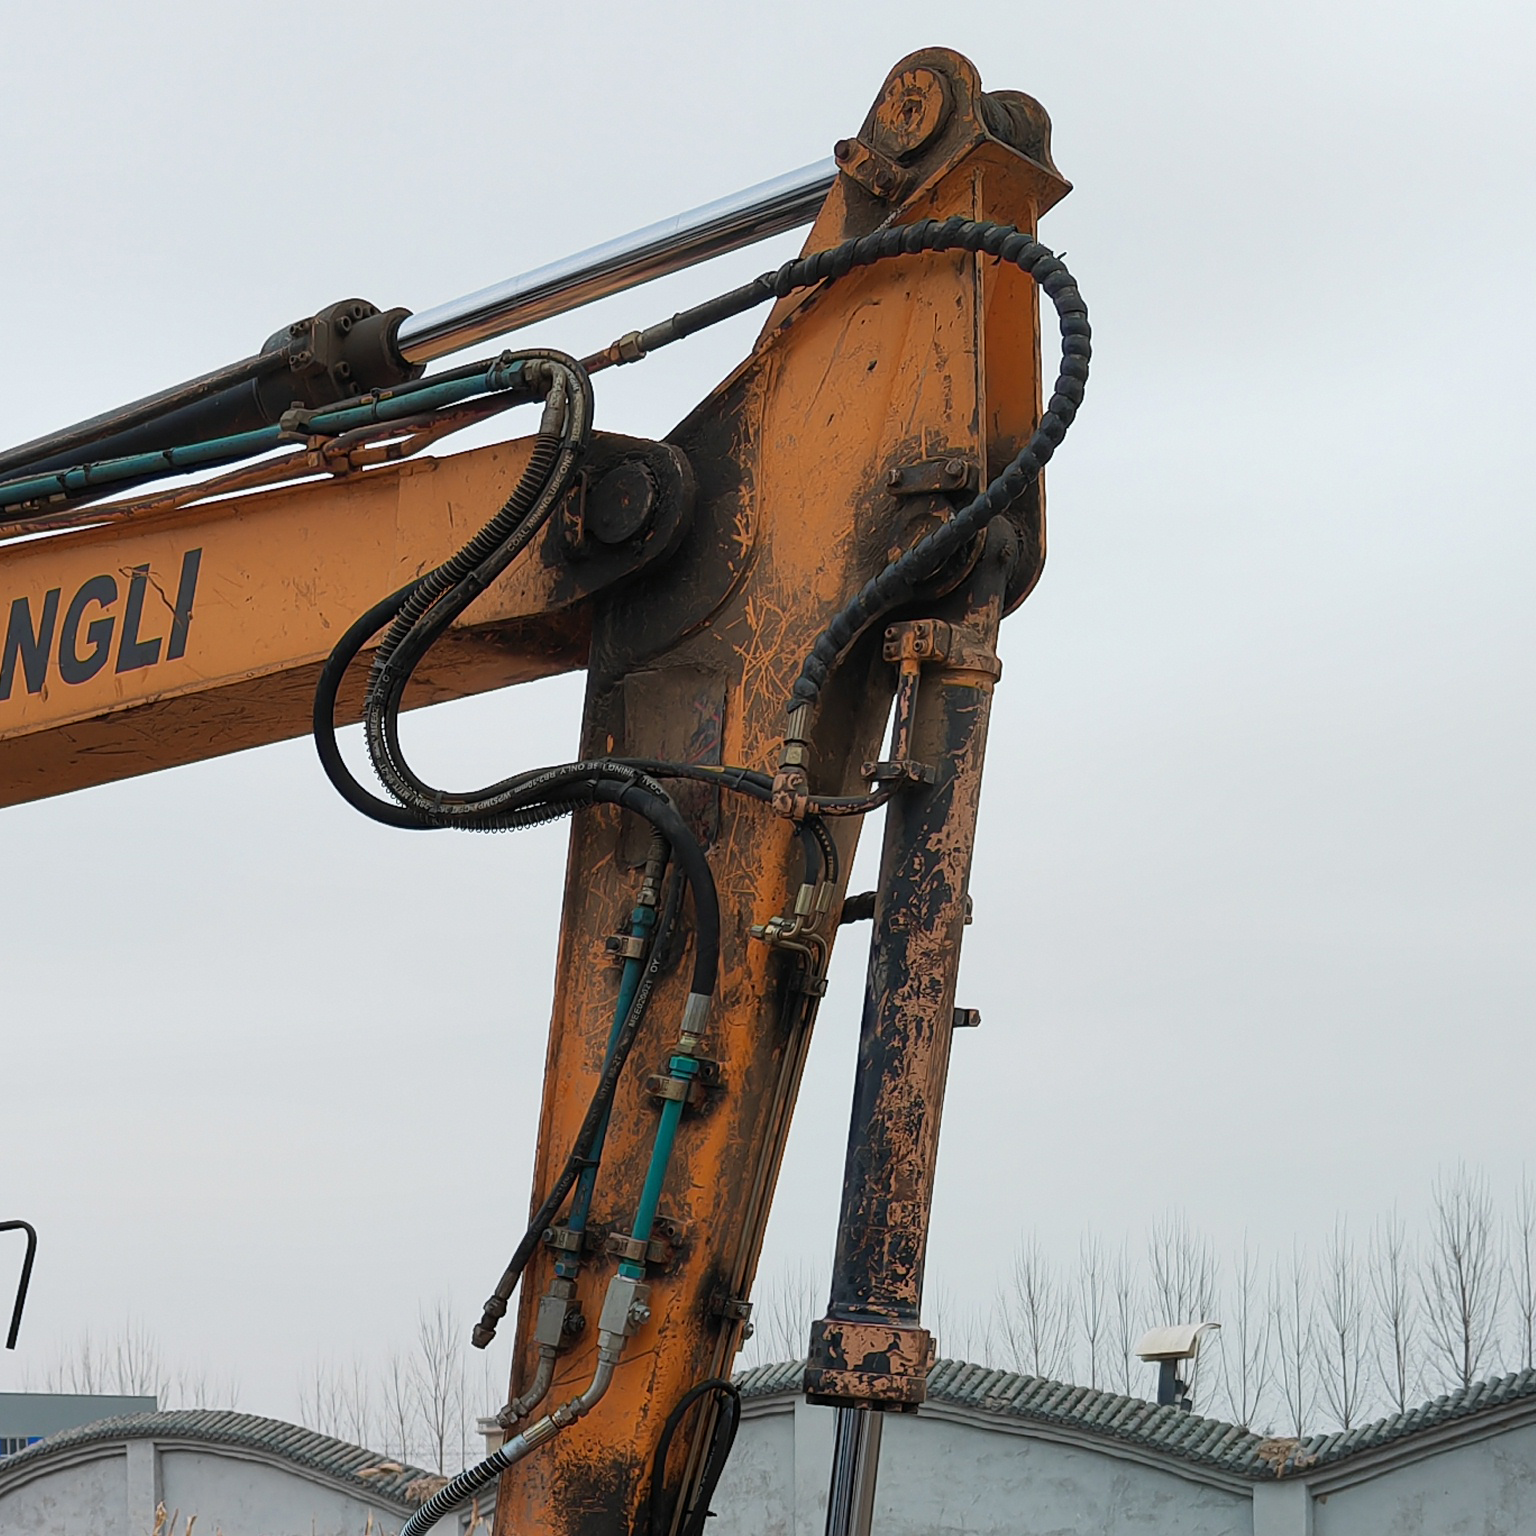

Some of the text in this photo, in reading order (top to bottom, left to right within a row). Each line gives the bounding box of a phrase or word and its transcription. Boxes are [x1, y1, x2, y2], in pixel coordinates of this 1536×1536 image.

[506, 527, 530, 552] COAL
[559, 762, 585, 774] ONLY
[640, 774, 663, 795] COAL
[650, 957, 661, 973] OY
